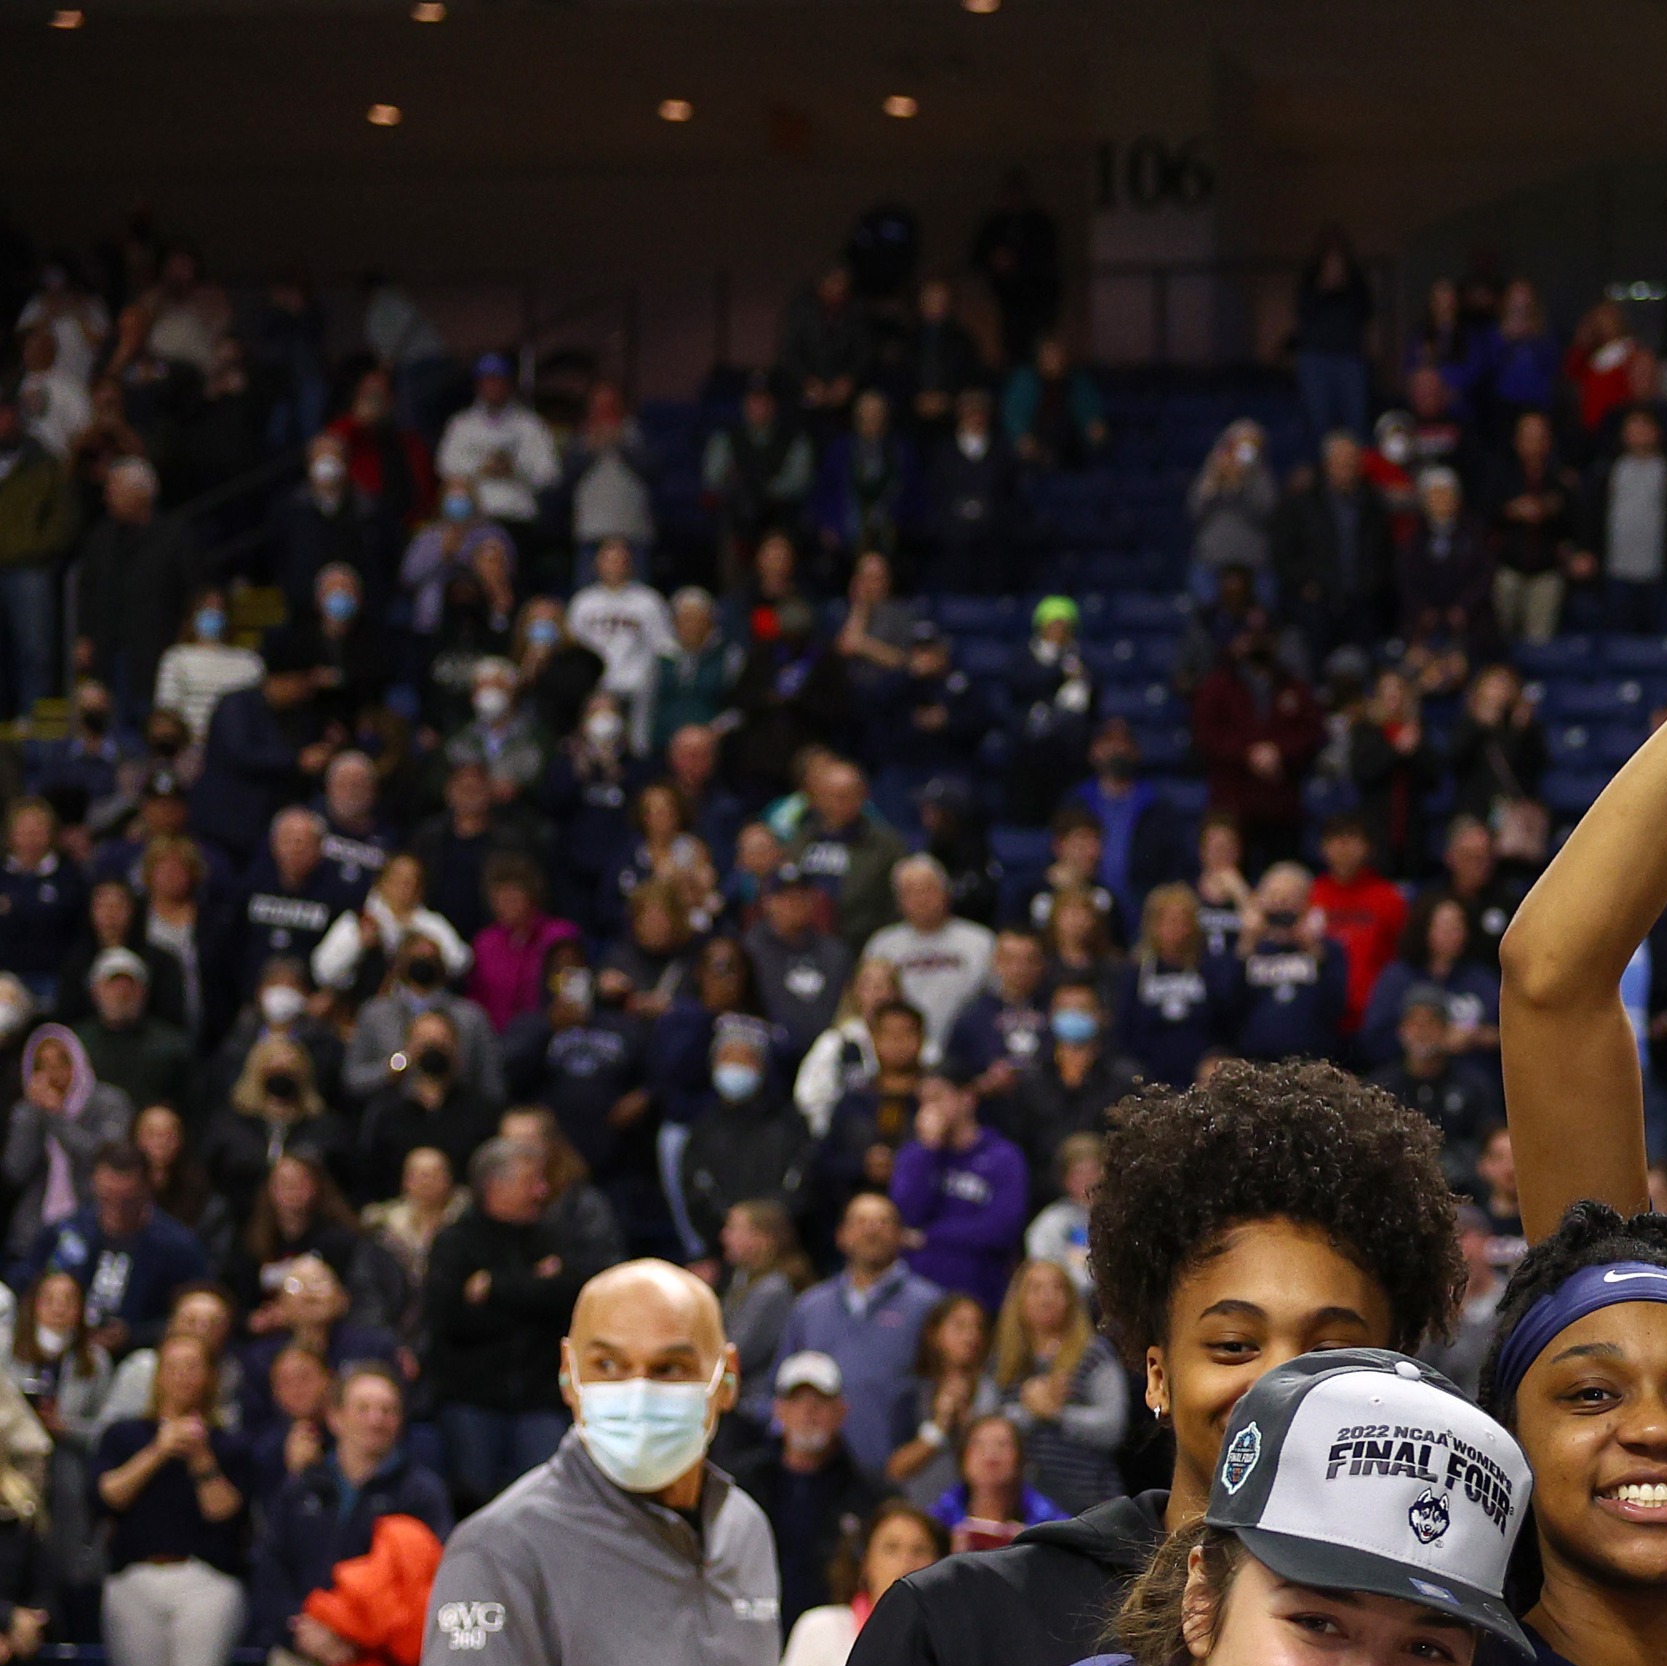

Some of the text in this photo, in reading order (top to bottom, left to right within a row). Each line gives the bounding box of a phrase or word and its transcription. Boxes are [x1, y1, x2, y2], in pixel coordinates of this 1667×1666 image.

[1336, 1424, 1390, 1442] 2022
[1392, 1425, 1449, 1447] NCAA
[1325, 1440, 1511, 1538] FINAL FOUR
